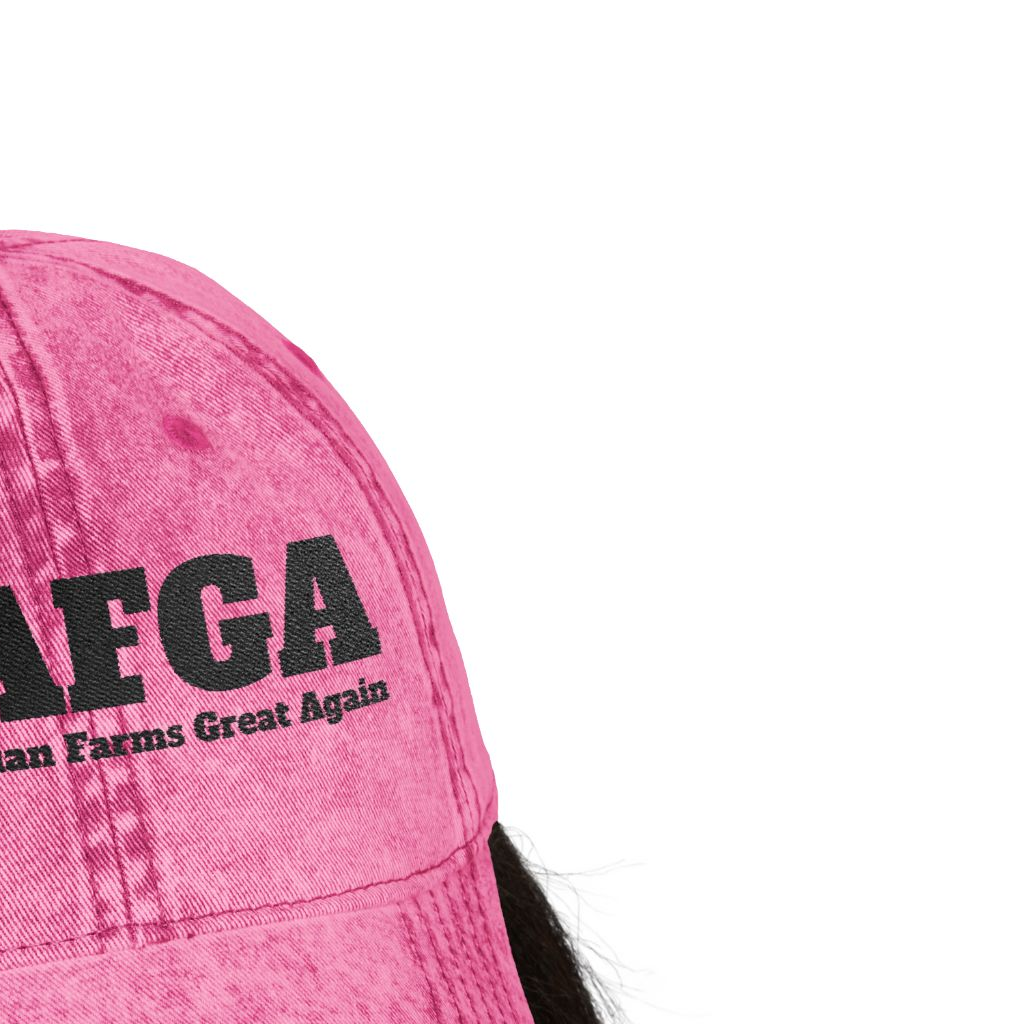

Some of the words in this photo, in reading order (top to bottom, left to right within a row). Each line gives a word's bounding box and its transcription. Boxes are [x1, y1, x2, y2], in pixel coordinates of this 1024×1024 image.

[62, 723, 186, 764] Farms
[193, 702, 292, 742] Great
[300, 677, 390, 725] Again
